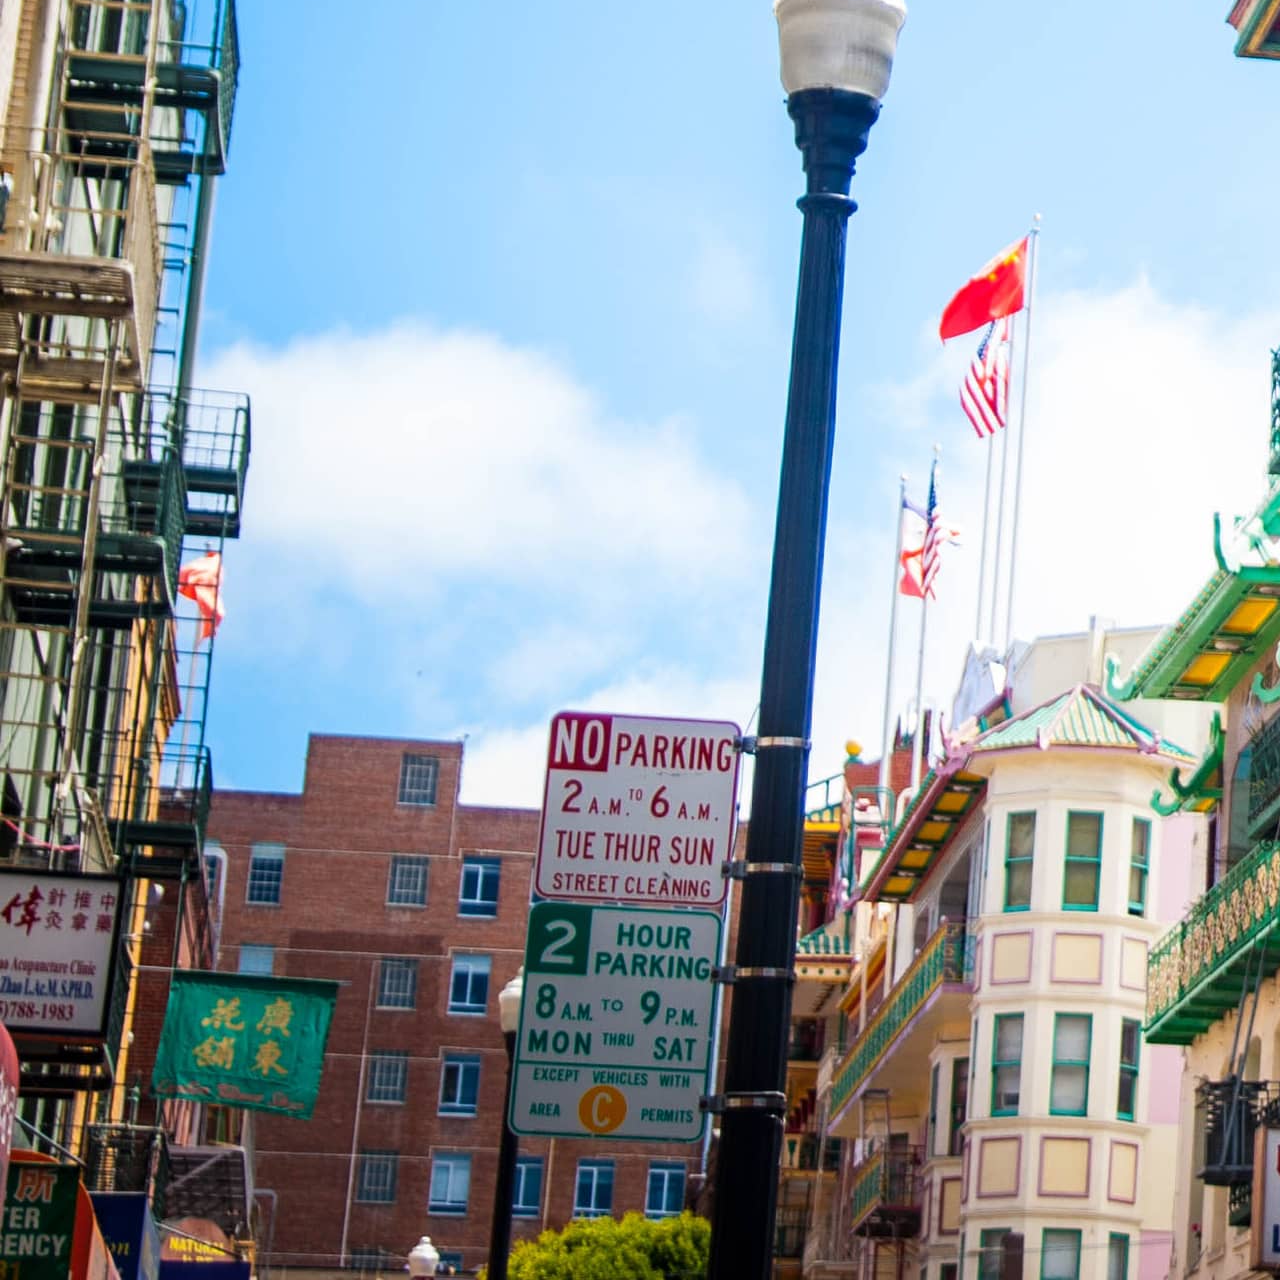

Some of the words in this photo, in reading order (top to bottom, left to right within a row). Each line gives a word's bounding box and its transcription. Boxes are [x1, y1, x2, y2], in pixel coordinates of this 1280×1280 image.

[554, 719, 605, 766] NO
[615, 732, 732, 772] PARKING
[561, 779, 583, 813] 2
[589, 797, 630, 817] A.M.
[629, 788, 643, 802] TO
[650, 785, 670, 818] 6
[677, 802, 719, 822] A.M.
[556, 829, 596, 860] TUE
[604, 832, 661, 863] THUR
[669, 836, 714, 866] SUN
[553, 872, 618, 894] STREET
[624, 876, 711, 898] CLEANING
[539, 919, 577, 964] 2
[617, 923, 691, 950] HOUR
[70, 959, 97, 976] Clinic
[595, 952, 711, 980] PARKING
[536, 983, 556, 1019] 8
[561, 1002, 593, 1021] A.M.
[601, 998, 624, 1012] TO
[640, 990, 661, 1025] 9
[665, 1007, 698, 1027] P.M.
[528, 1029, 592, 1055] MON
[602, 1032, 634, 1047] THRU
[653, 1037, 696, 1061] SAT
[533, 1067, 580, 1082] EXCEPT
[593, 1070, 648, 1086] VEHICLES
[659, 1074, 690, 1088] WITH
[529, 1102, 561, 1117] AREA
[592, 1091, 612, 1128] C
[641, 1107, 693, 1124] PERMITS
[0, 1233, 67, 1257] ENCY
